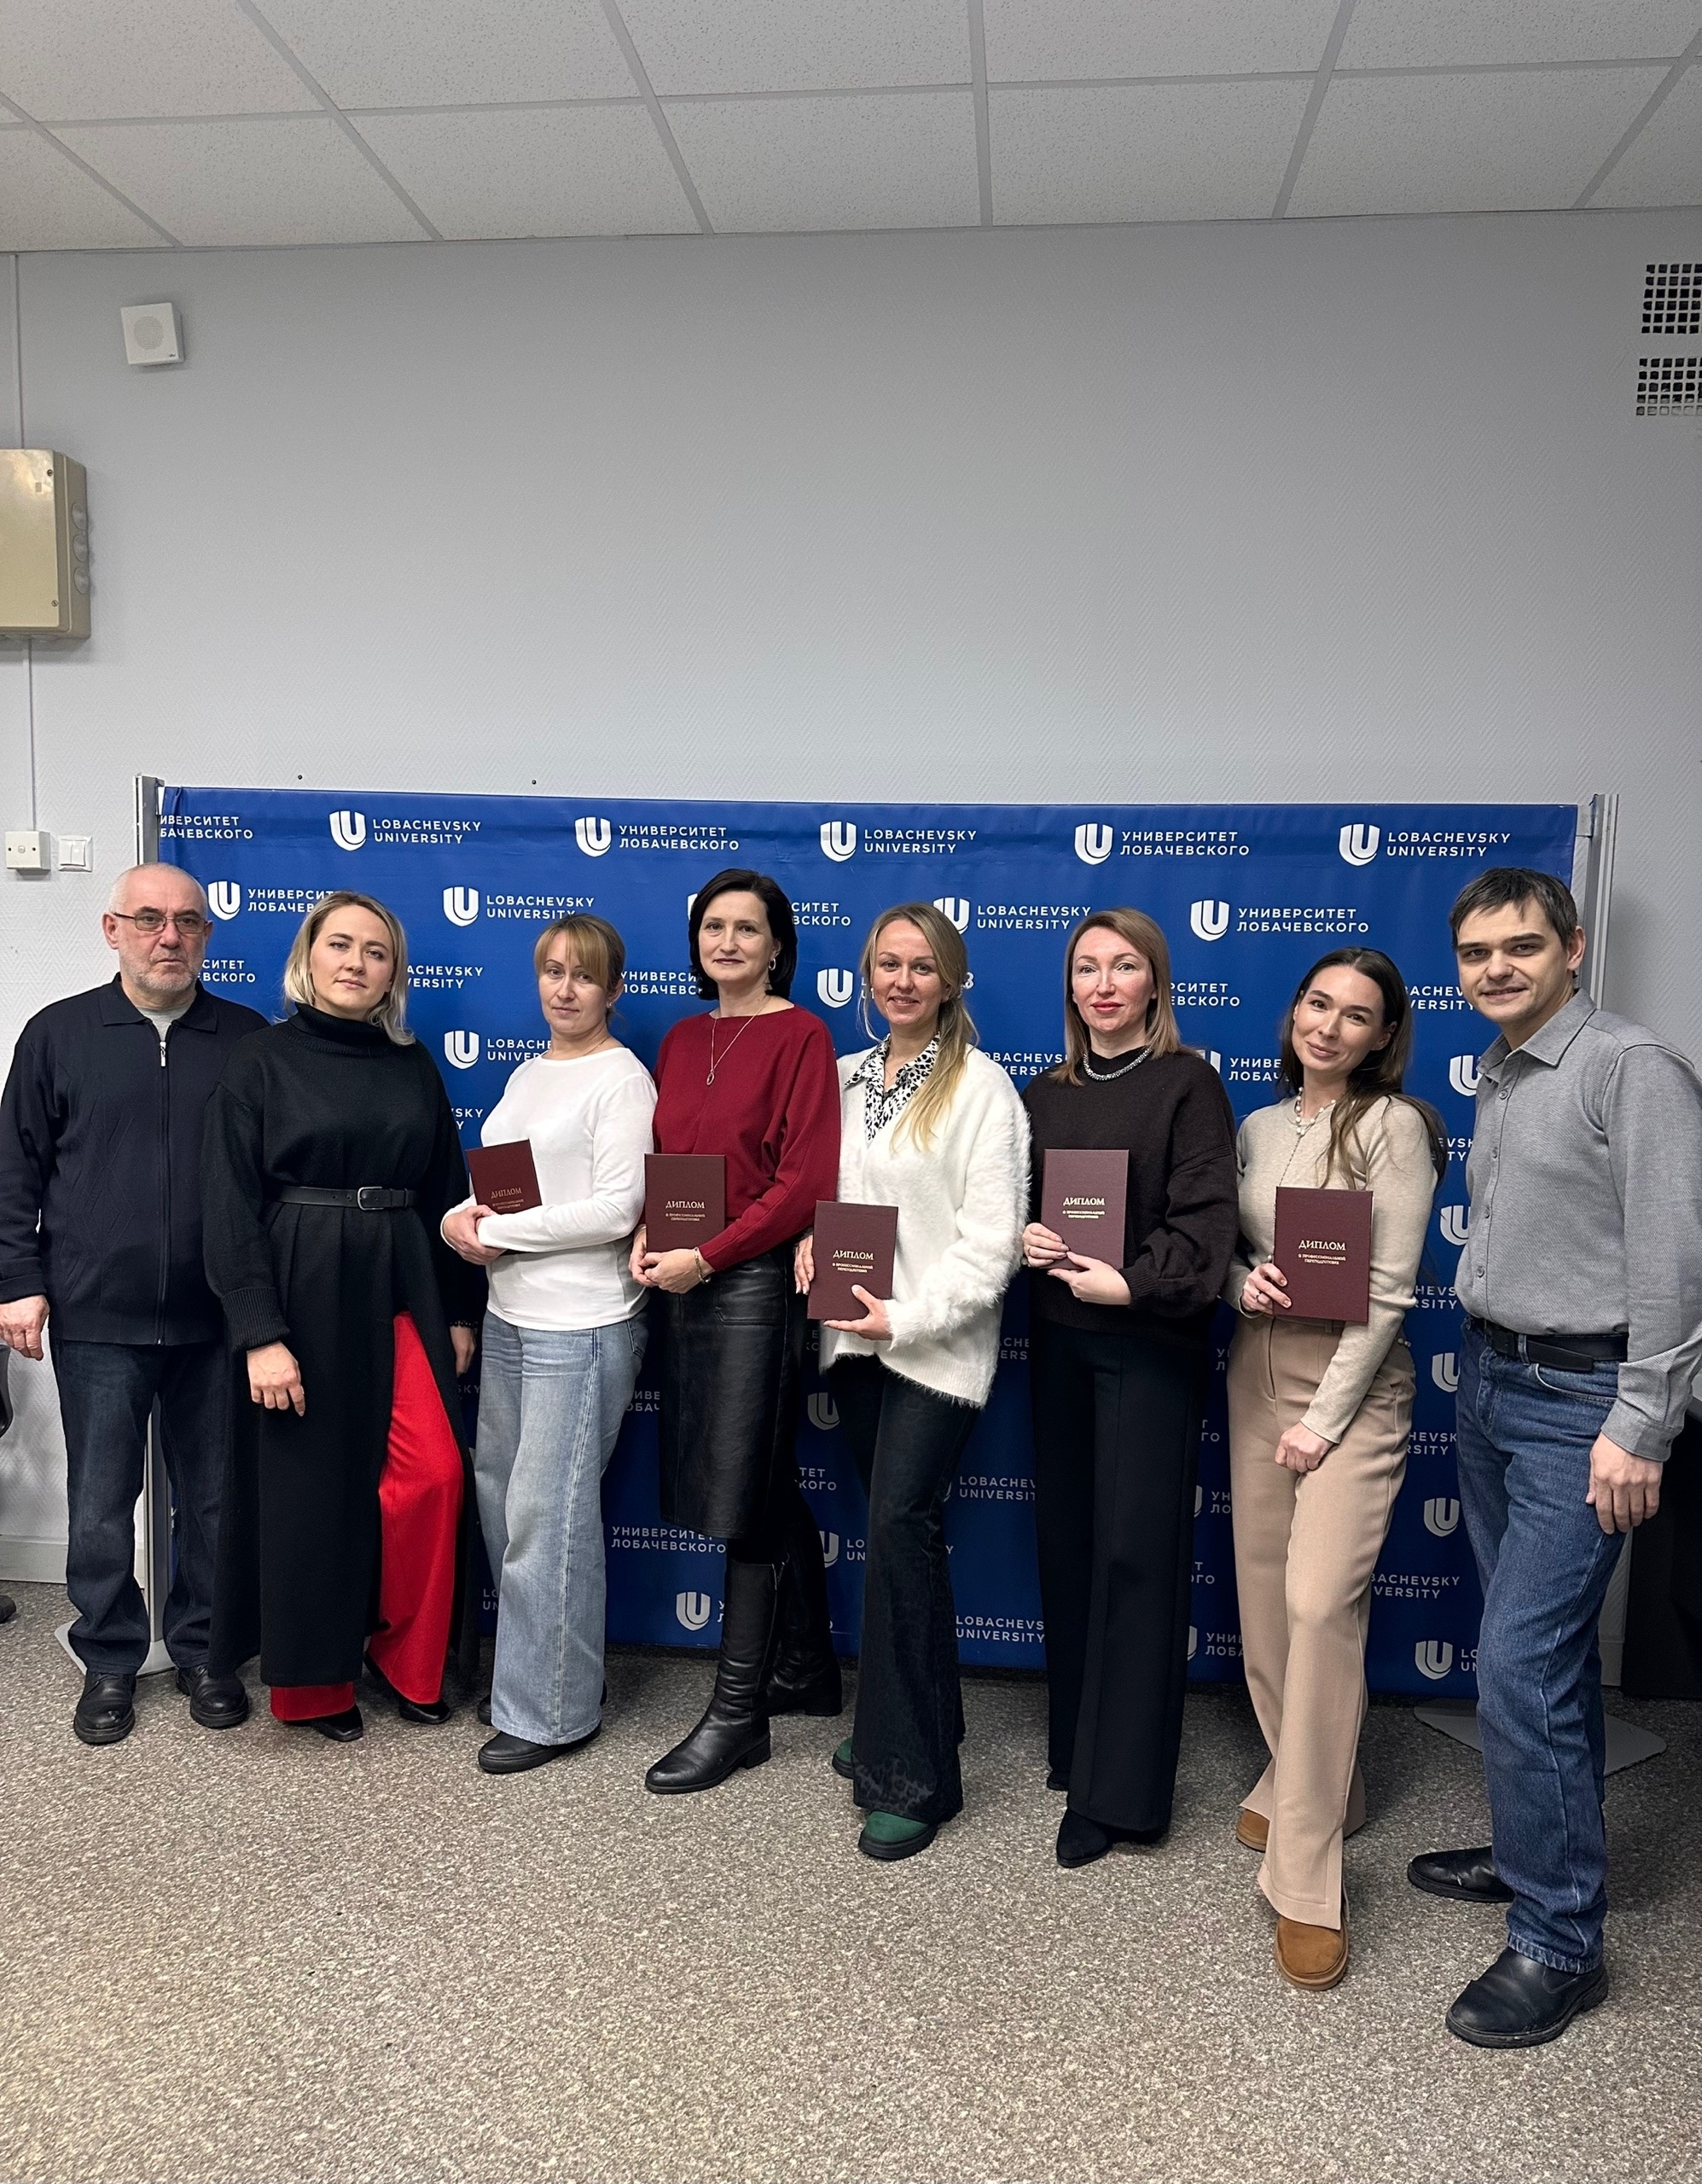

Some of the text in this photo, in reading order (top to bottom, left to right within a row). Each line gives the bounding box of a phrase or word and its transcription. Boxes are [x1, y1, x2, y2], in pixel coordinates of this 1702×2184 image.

[373, 819, 480, 832] LOBACHEVSKY
[619, 826, 726, 838] УНИВЕРСИТЕТ
[865, 829, 976, 839] LOBACHEVSKY
[1122, 832, 1237, 841] УНИВЕРСИТЕТ
[375, 833, 462, 844] UNIVERSITY
[1389, 833, 1510, 843] LOBACHEVSKY
[619, 839, 738, 850] ЛОБАЧЕВСКОГО
[865, 843, 956, 853] UNIVERSITY
[1120, 845, 1249, 855] ЛОБАЧЕВСКОГО
[1387, 846, 1486, 857] UNIVERSITY
[487, 896, 594, 908] LOBACHEVSKY
[978, 906, 1090, 917] LOBACHEVSKY
[1239, 909, 1356, 918] УНИВЕРСИТЕТ
[978, 919, 1069, 929] UNIVERSITY
[1237, 922, 1368, 932] ЛОБАЧЕВСКОГО
[491, 1187, 522, 1199] ДИПЛОМ
[665, 1200, 705, 1209] ДИПЛОМ
[1063, 1197, 1106, 1206] ДИПЛОМ
[1298, 1240, 1346, 1251] ДИПЛОМ
[833, 1250, 874, 1261] ДИПЛОМ
[612, 1538, 725, 1553] ЛОБАЧЕВСКОГО
[956, 1628, 1045, 1644] UNIVERSITY
